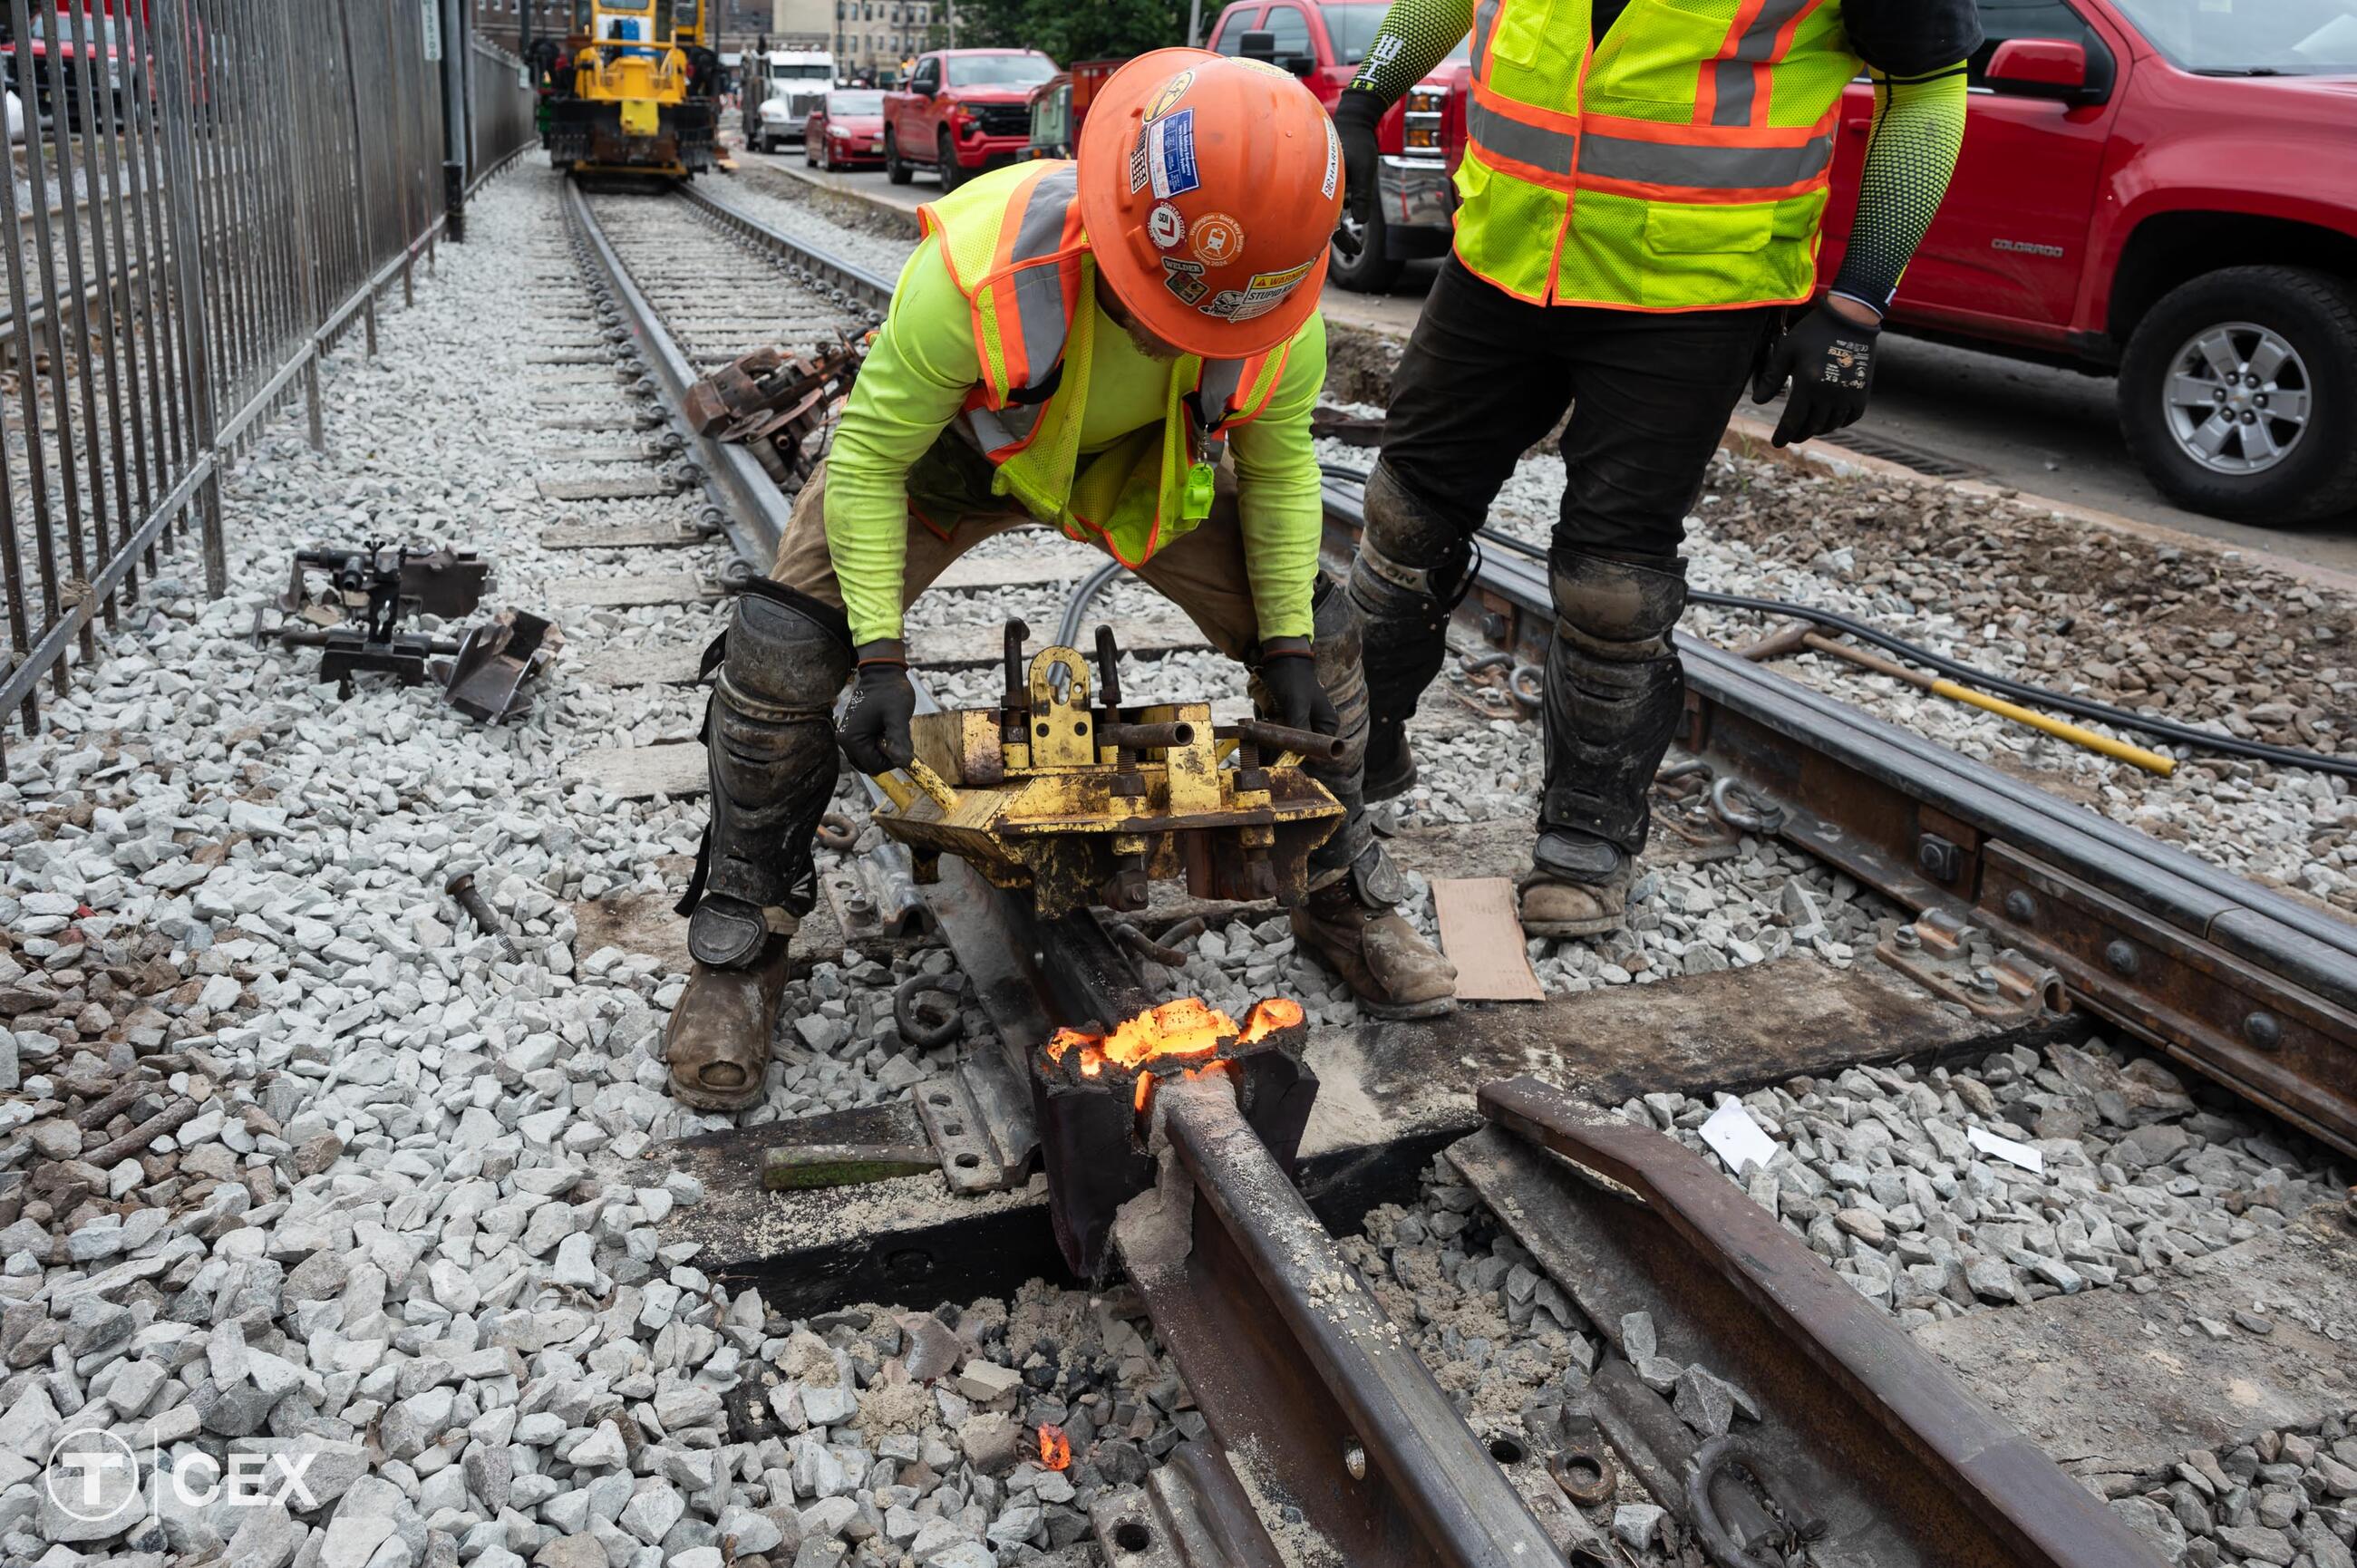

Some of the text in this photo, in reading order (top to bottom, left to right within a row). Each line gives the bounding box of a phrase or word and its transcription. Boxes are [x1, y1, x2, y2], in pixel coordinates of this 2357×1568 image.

[1160, 201, 1186, 239] CONTRACTOR
[1992, 238, 2063, 257] COLORADO
[1165, 259, 1201, 273] WELDER
[1248, 288, 1281, 300] STUPID
